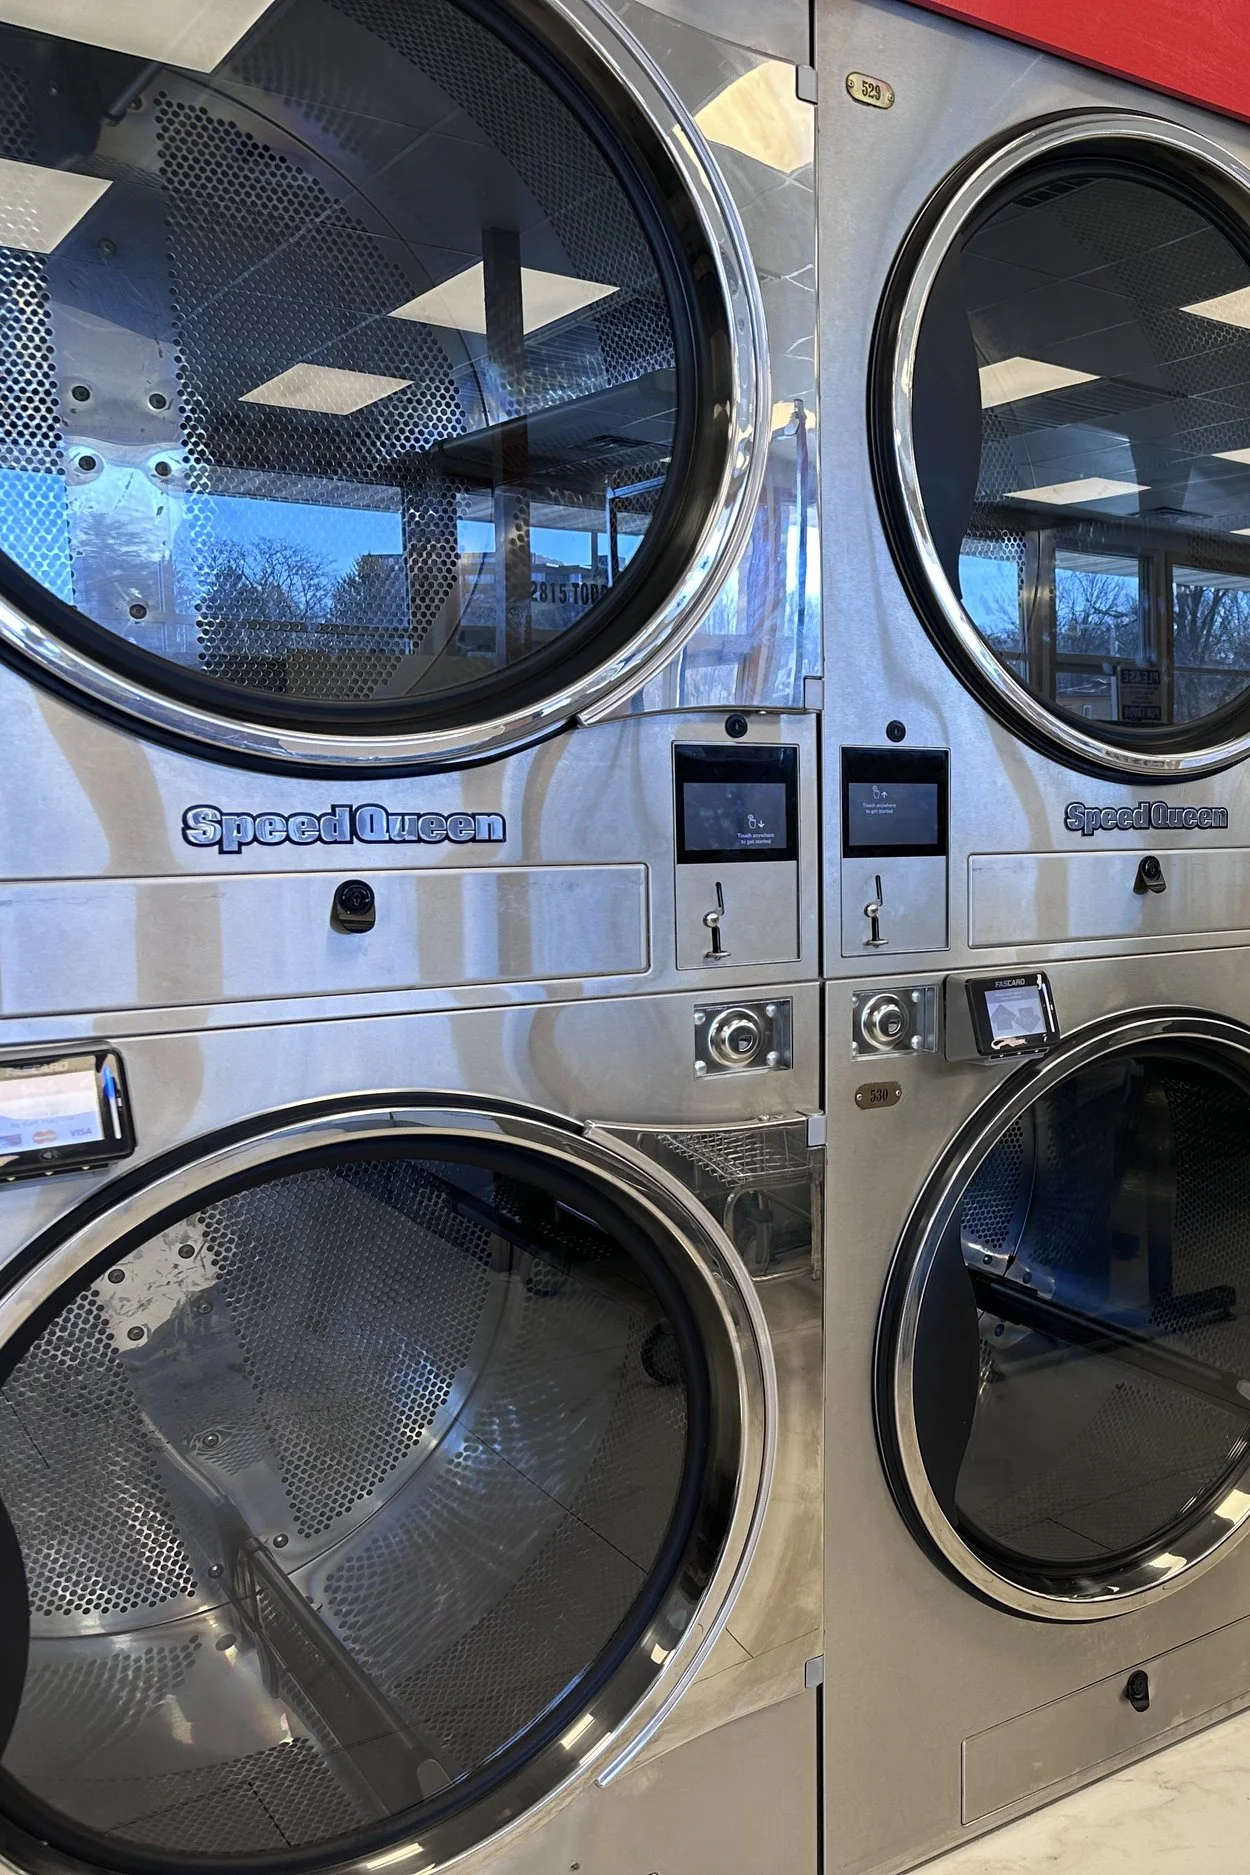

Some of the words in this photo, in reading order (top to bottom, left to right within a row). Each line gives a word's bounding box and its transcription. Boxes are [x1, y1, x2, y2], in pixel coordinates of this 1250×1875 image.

[862, 80, 881, 101] 529
[531, 580, 567, 604] 2815
[183, 804, 352, 853] Speed
[354, 804, 506, 842] Queen
[1065, 802, 1149, 836] Speed
[1150, 801, 1228, 829] Queen
[995, 978, 1025, 988] FASCARD
[870, 1088, 889, 1103] 530
[69, 1127, 92, 1137] VISA
